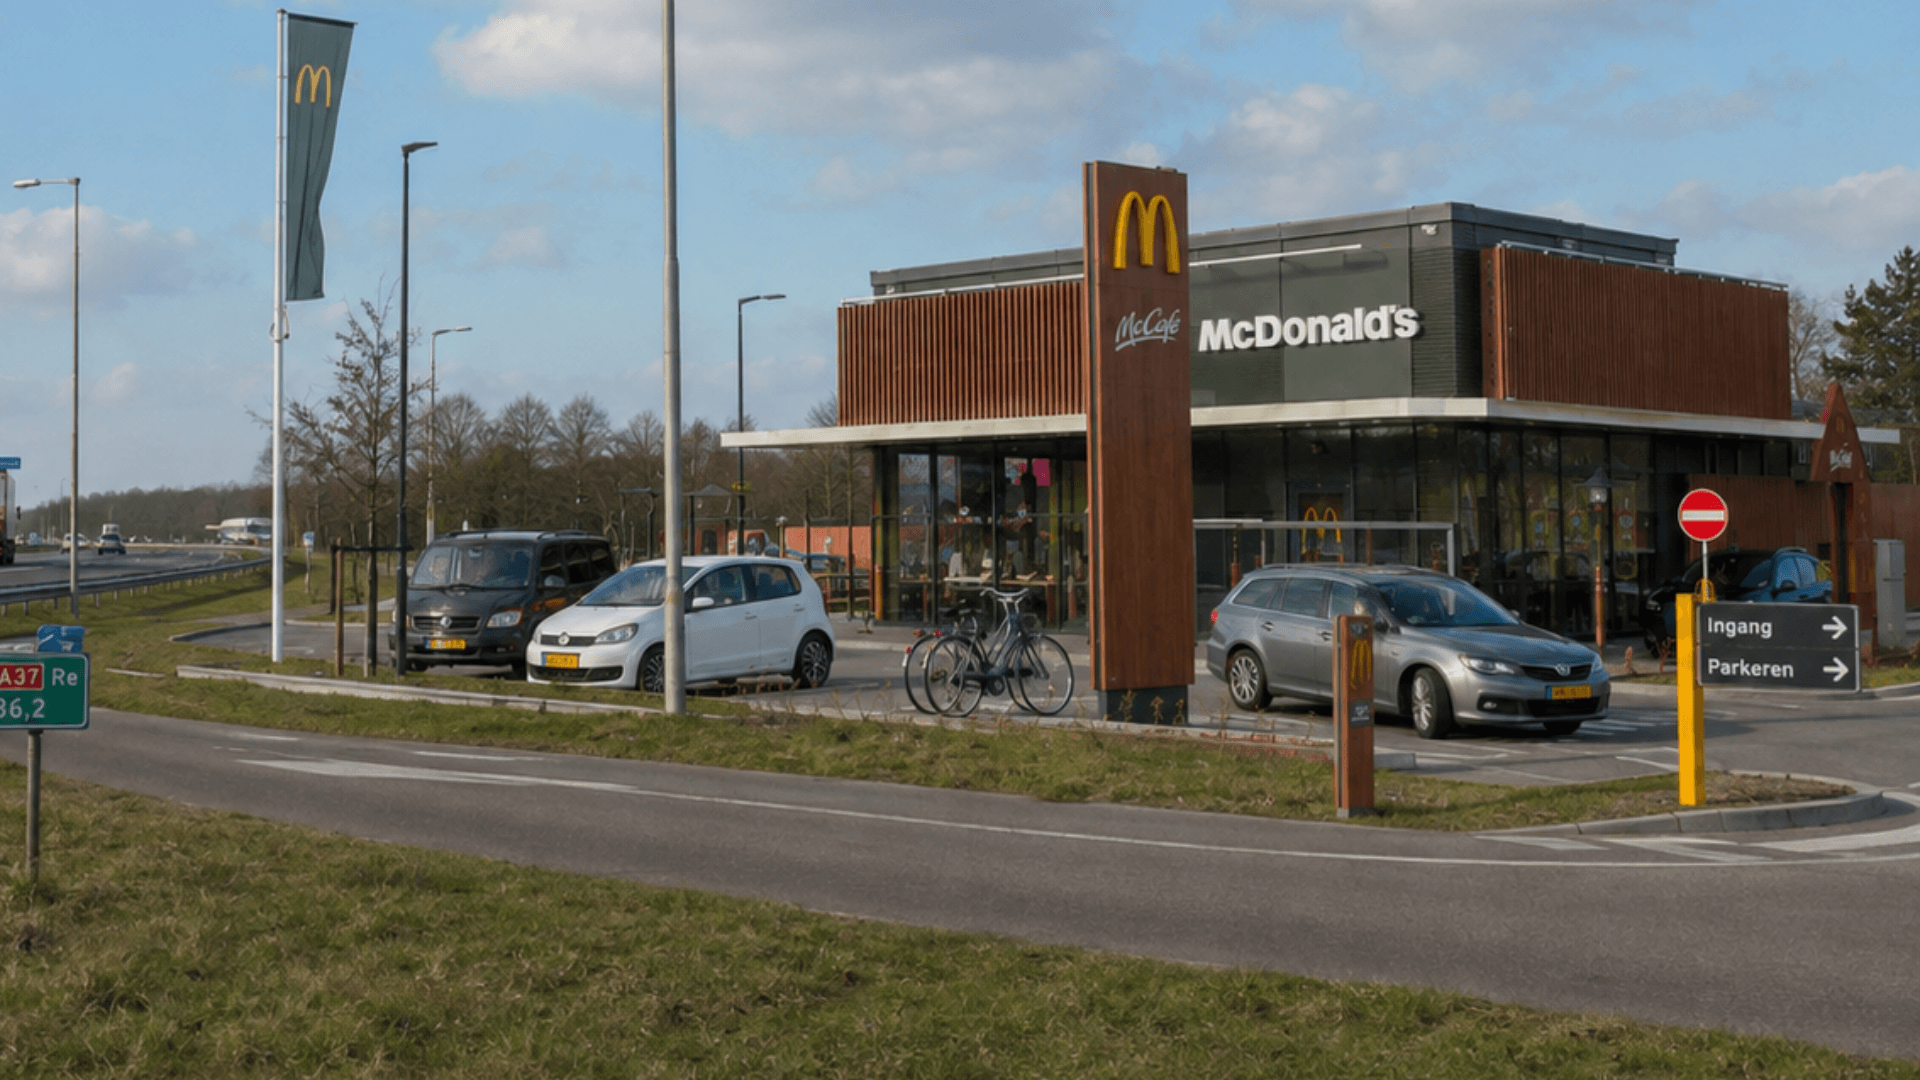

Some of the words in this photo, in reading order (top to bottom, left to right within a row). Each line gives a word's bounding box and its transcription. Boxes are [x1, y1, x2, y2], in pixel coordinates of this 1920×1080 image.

[1199, 304, 1420, 352] McDonald's
[1708, 617, 1772, 639] Ingang
[0, 667, 40, 686] A37
[52, 667, 78, 687] Re
[1708, 658, 1794, 678] Parkeren
